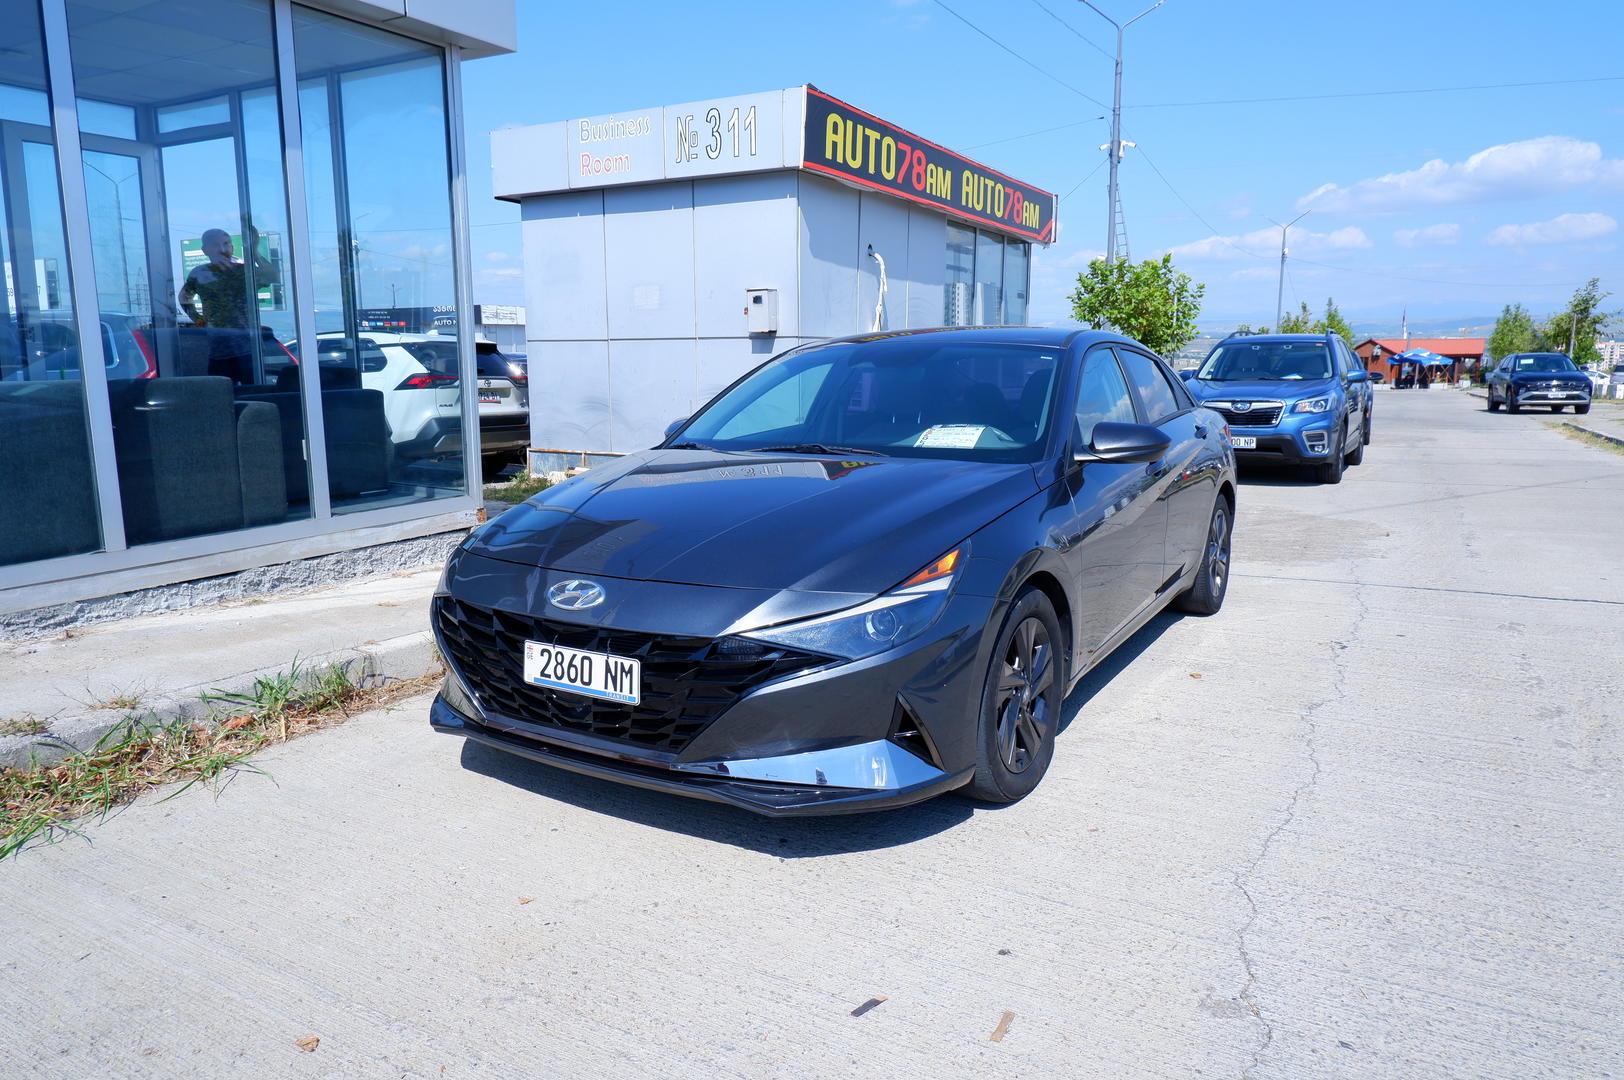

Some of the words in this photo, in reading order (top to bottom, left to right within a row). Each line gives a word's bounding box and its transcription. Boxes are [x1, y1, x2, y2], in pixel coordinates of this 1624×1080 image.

[579, 113, 651, 144] Business
[705, 105, 757, 160] 311
[580, 152, 631, 176] Room
[540, 648, 593, 687] 2860
[604, 658, 634, 695] NM
